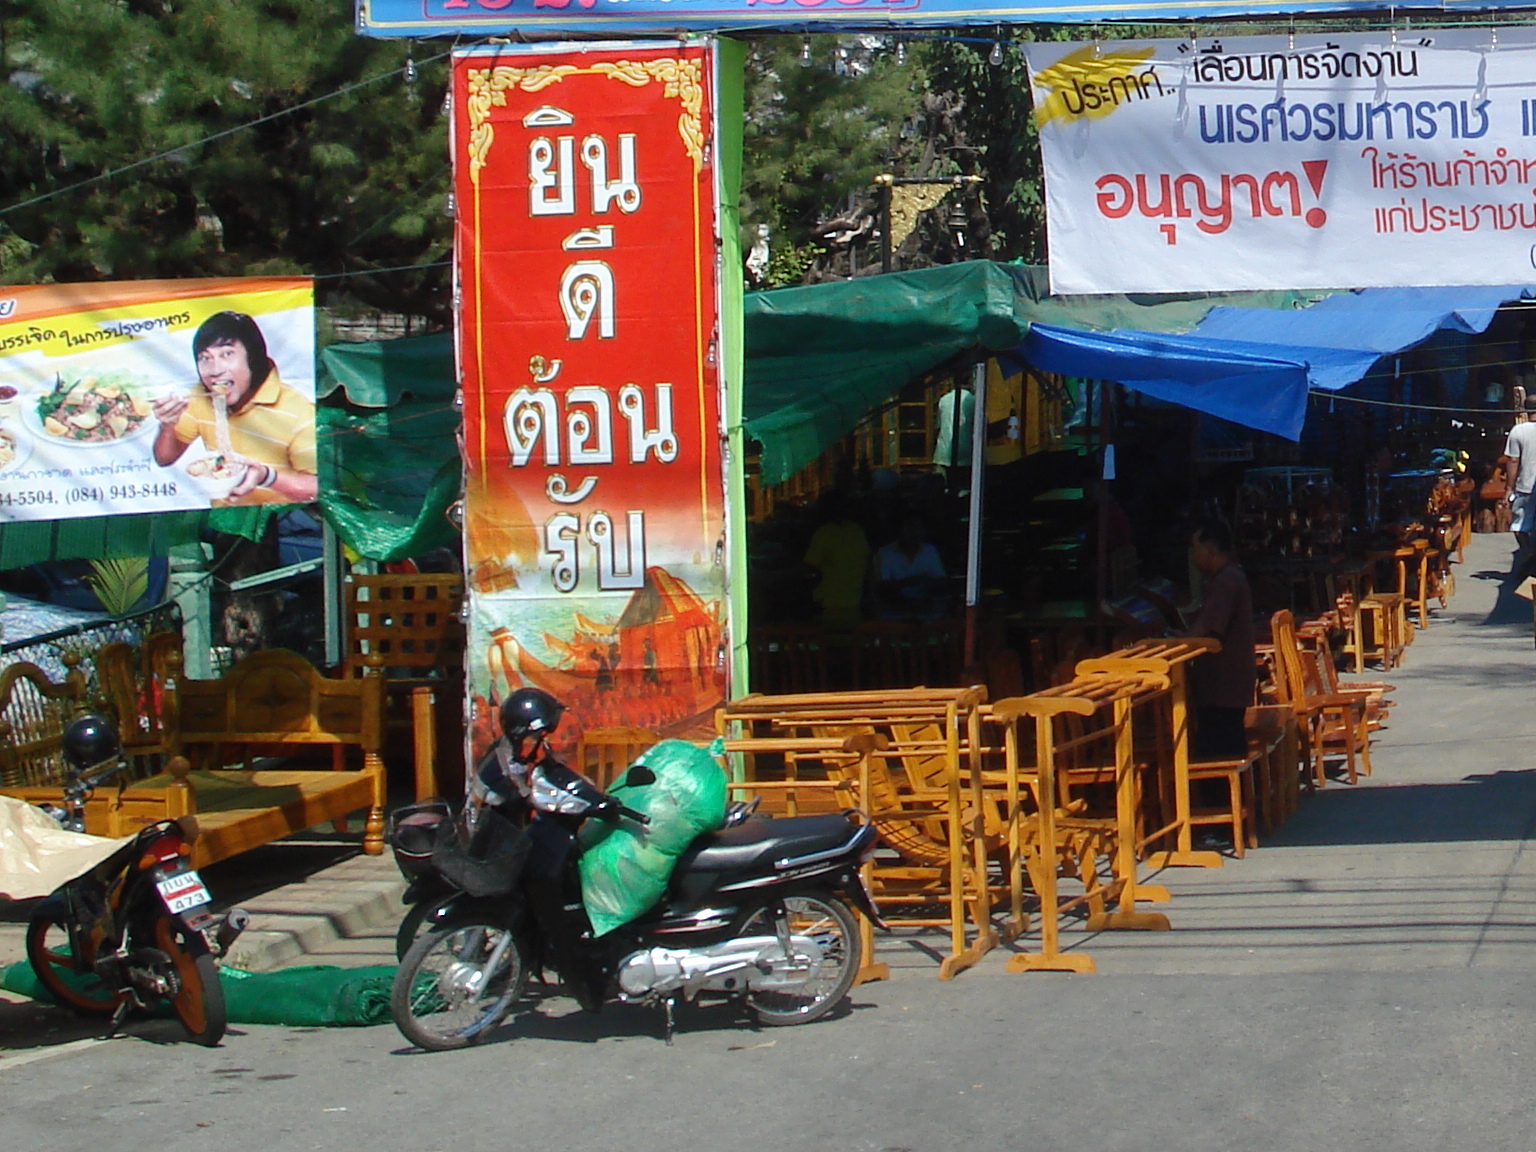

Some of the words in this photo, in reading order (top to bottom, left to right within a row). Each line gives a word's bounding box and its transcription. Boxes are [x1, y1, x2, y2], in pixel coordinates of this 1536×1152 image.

[522, 104, 643, 217] ยิน
[1199, 97, 1491, 144] นเรศวรมหาราช
[1095, 160, 1329, 246] อนุญาต!
[558, 225, 615, 341] ดี
[503, 354, 679, 468] ต้อน
[110, 481, 178, 501] 943-8448
[543, 472, 647, 592] รับ
[175, 893, 205, 910] 473
